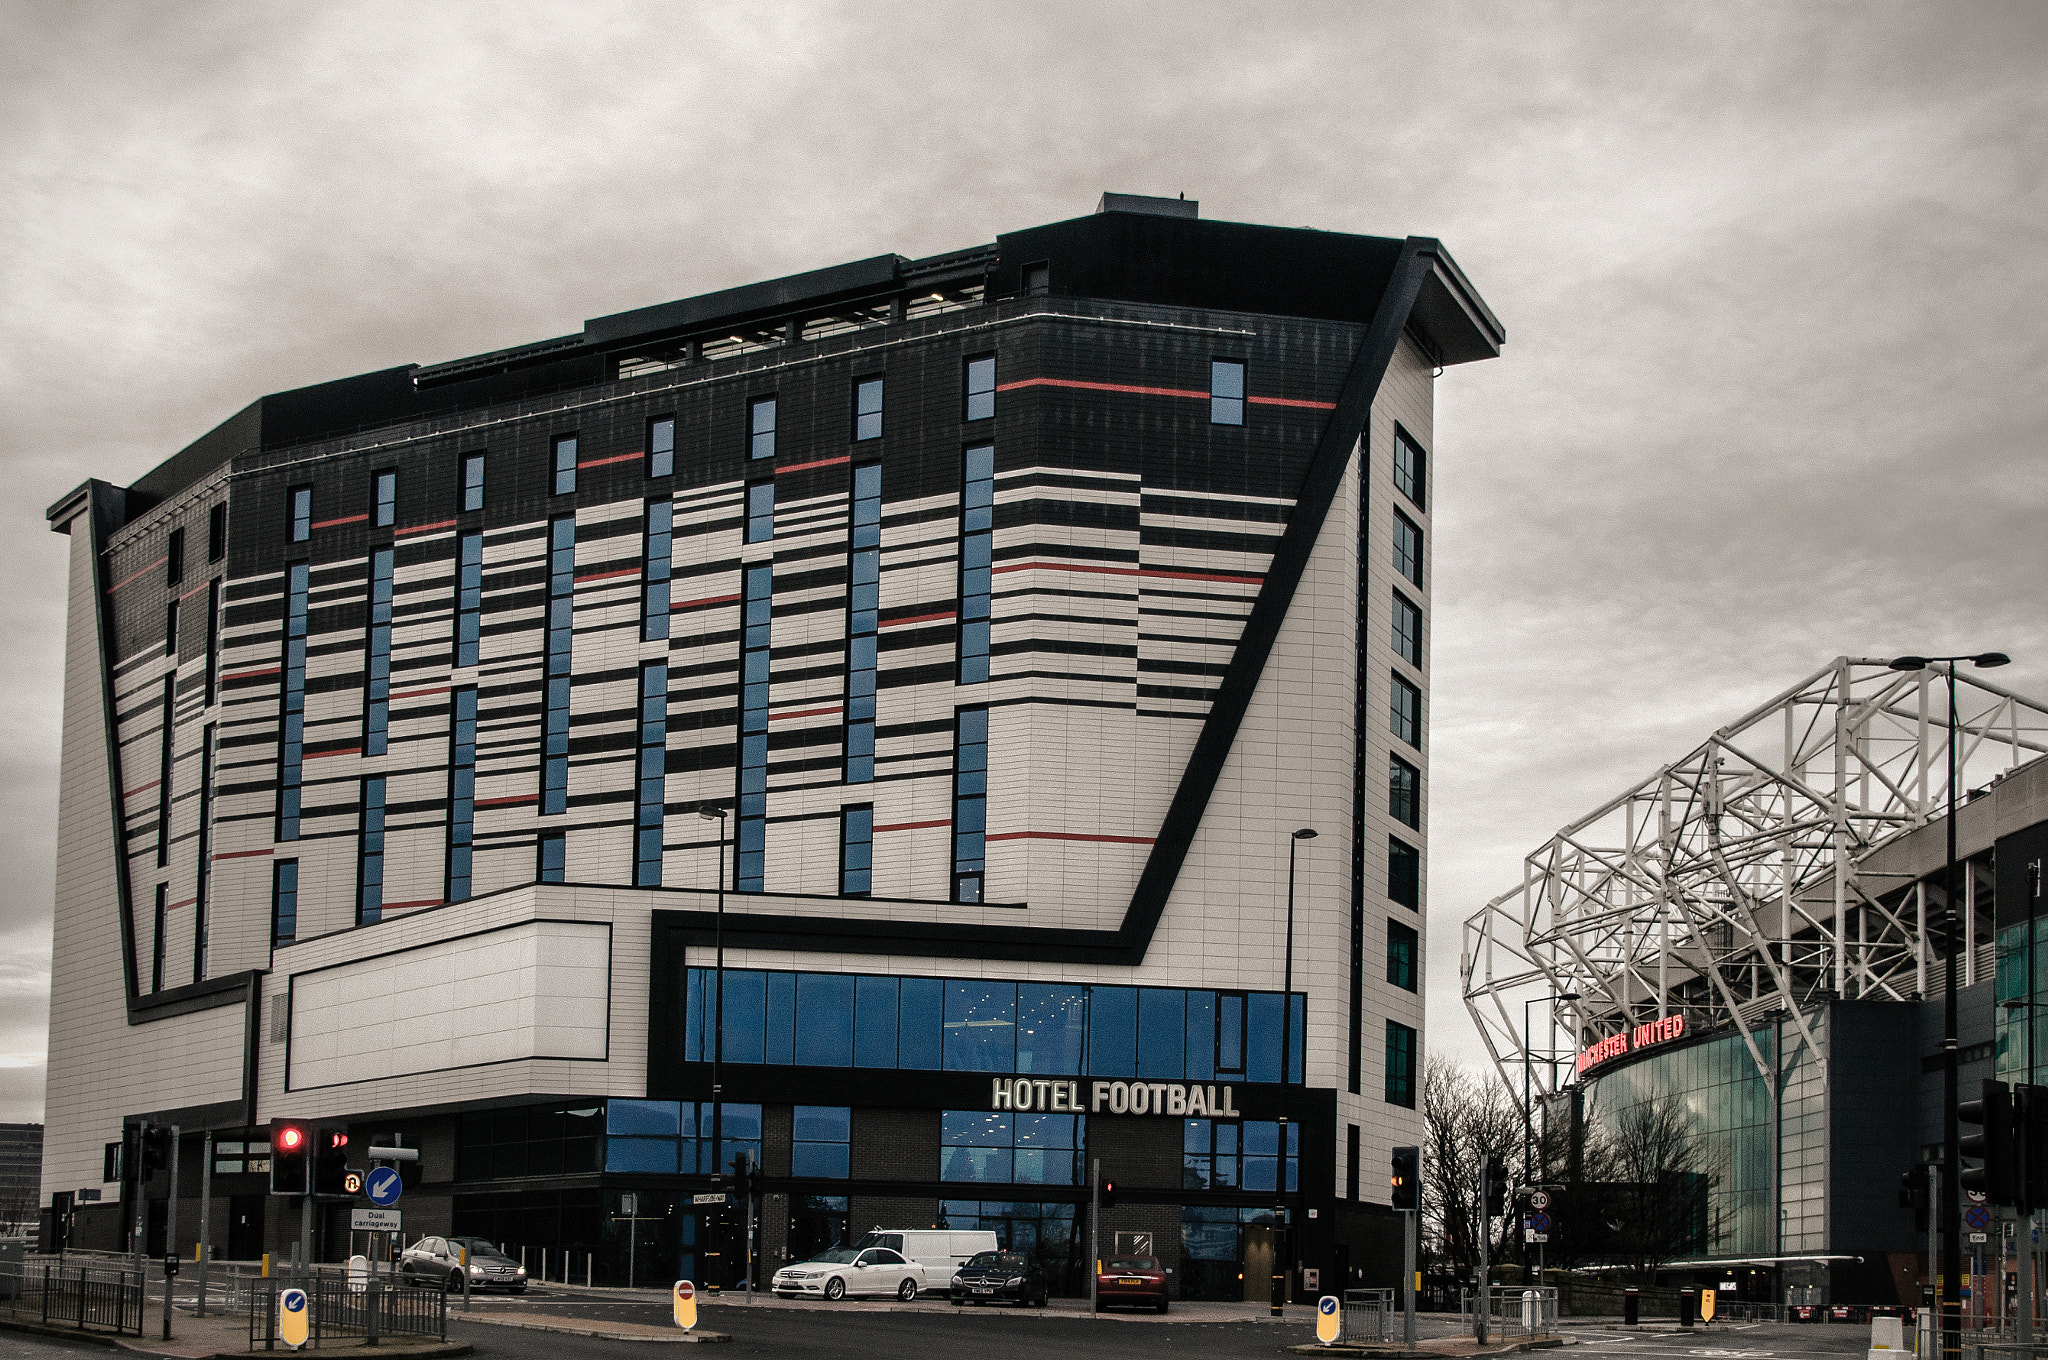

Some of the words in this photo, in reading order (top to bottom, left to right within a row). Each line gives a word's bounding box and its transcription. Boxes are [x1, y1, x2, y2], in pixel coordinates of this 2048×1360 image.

[1578, 1032, 1628, 1073] MANCHESTER
[1633, 1014, 1684, 1049] UNITED
[992, 1078, 1085, 1112] HOTEL
[1092, 1081, 1240, 1117] FOOTBALL
[1532, 1196, 1546, 1205] 30
[368, 1211, 385, 1219] Dual
[354, 1220, 398, 1228] carriageway
